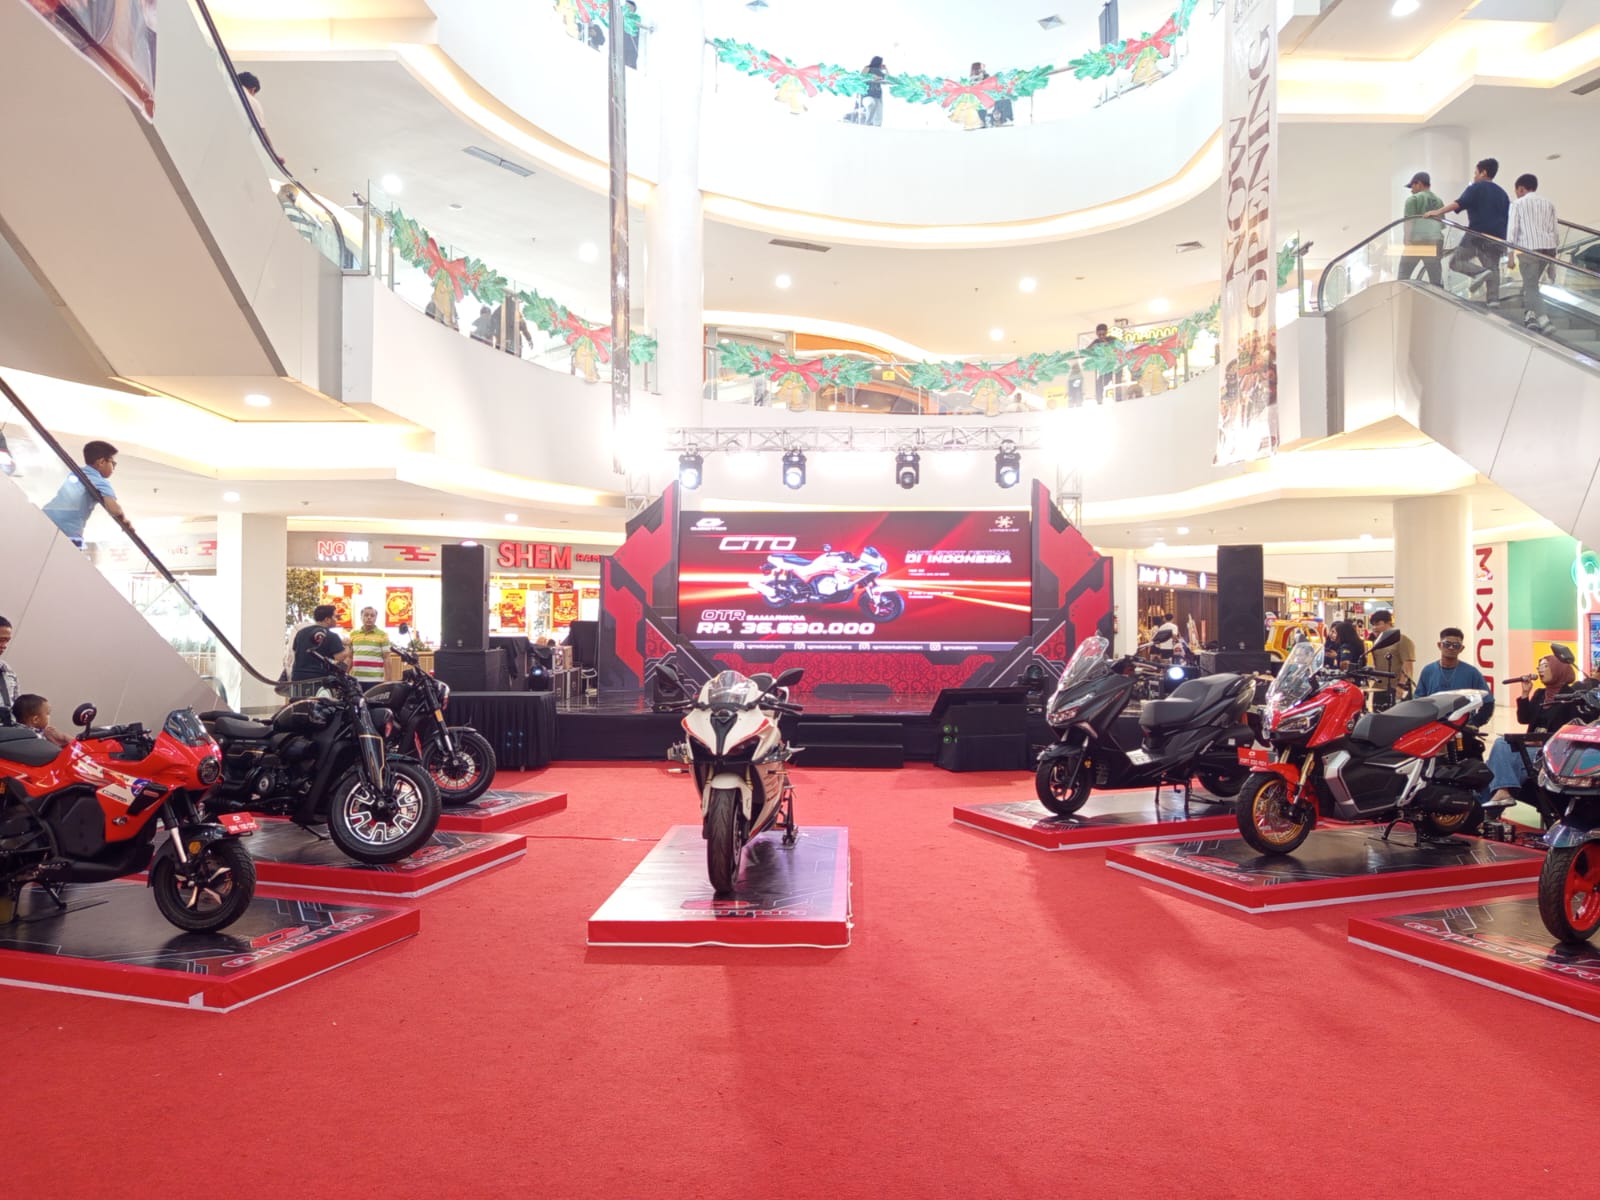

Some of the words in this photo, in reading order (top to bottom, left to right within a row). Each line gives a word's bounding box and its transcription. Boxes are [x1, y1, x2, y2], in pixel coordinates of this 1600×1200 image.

[1246, 24, 1271, 319] OPENING
[1226, 116, 1246, 283] NOW
[497, 541, 573, 570] SHEM
[904, 554, 922, 564] DI
[927, 554, 1012, 564] INDONESIA
[701, 609, 746, 621] OTR
[696, 622, 732, 635] RP.
[739, 622, 875, 635] 36.690.000
